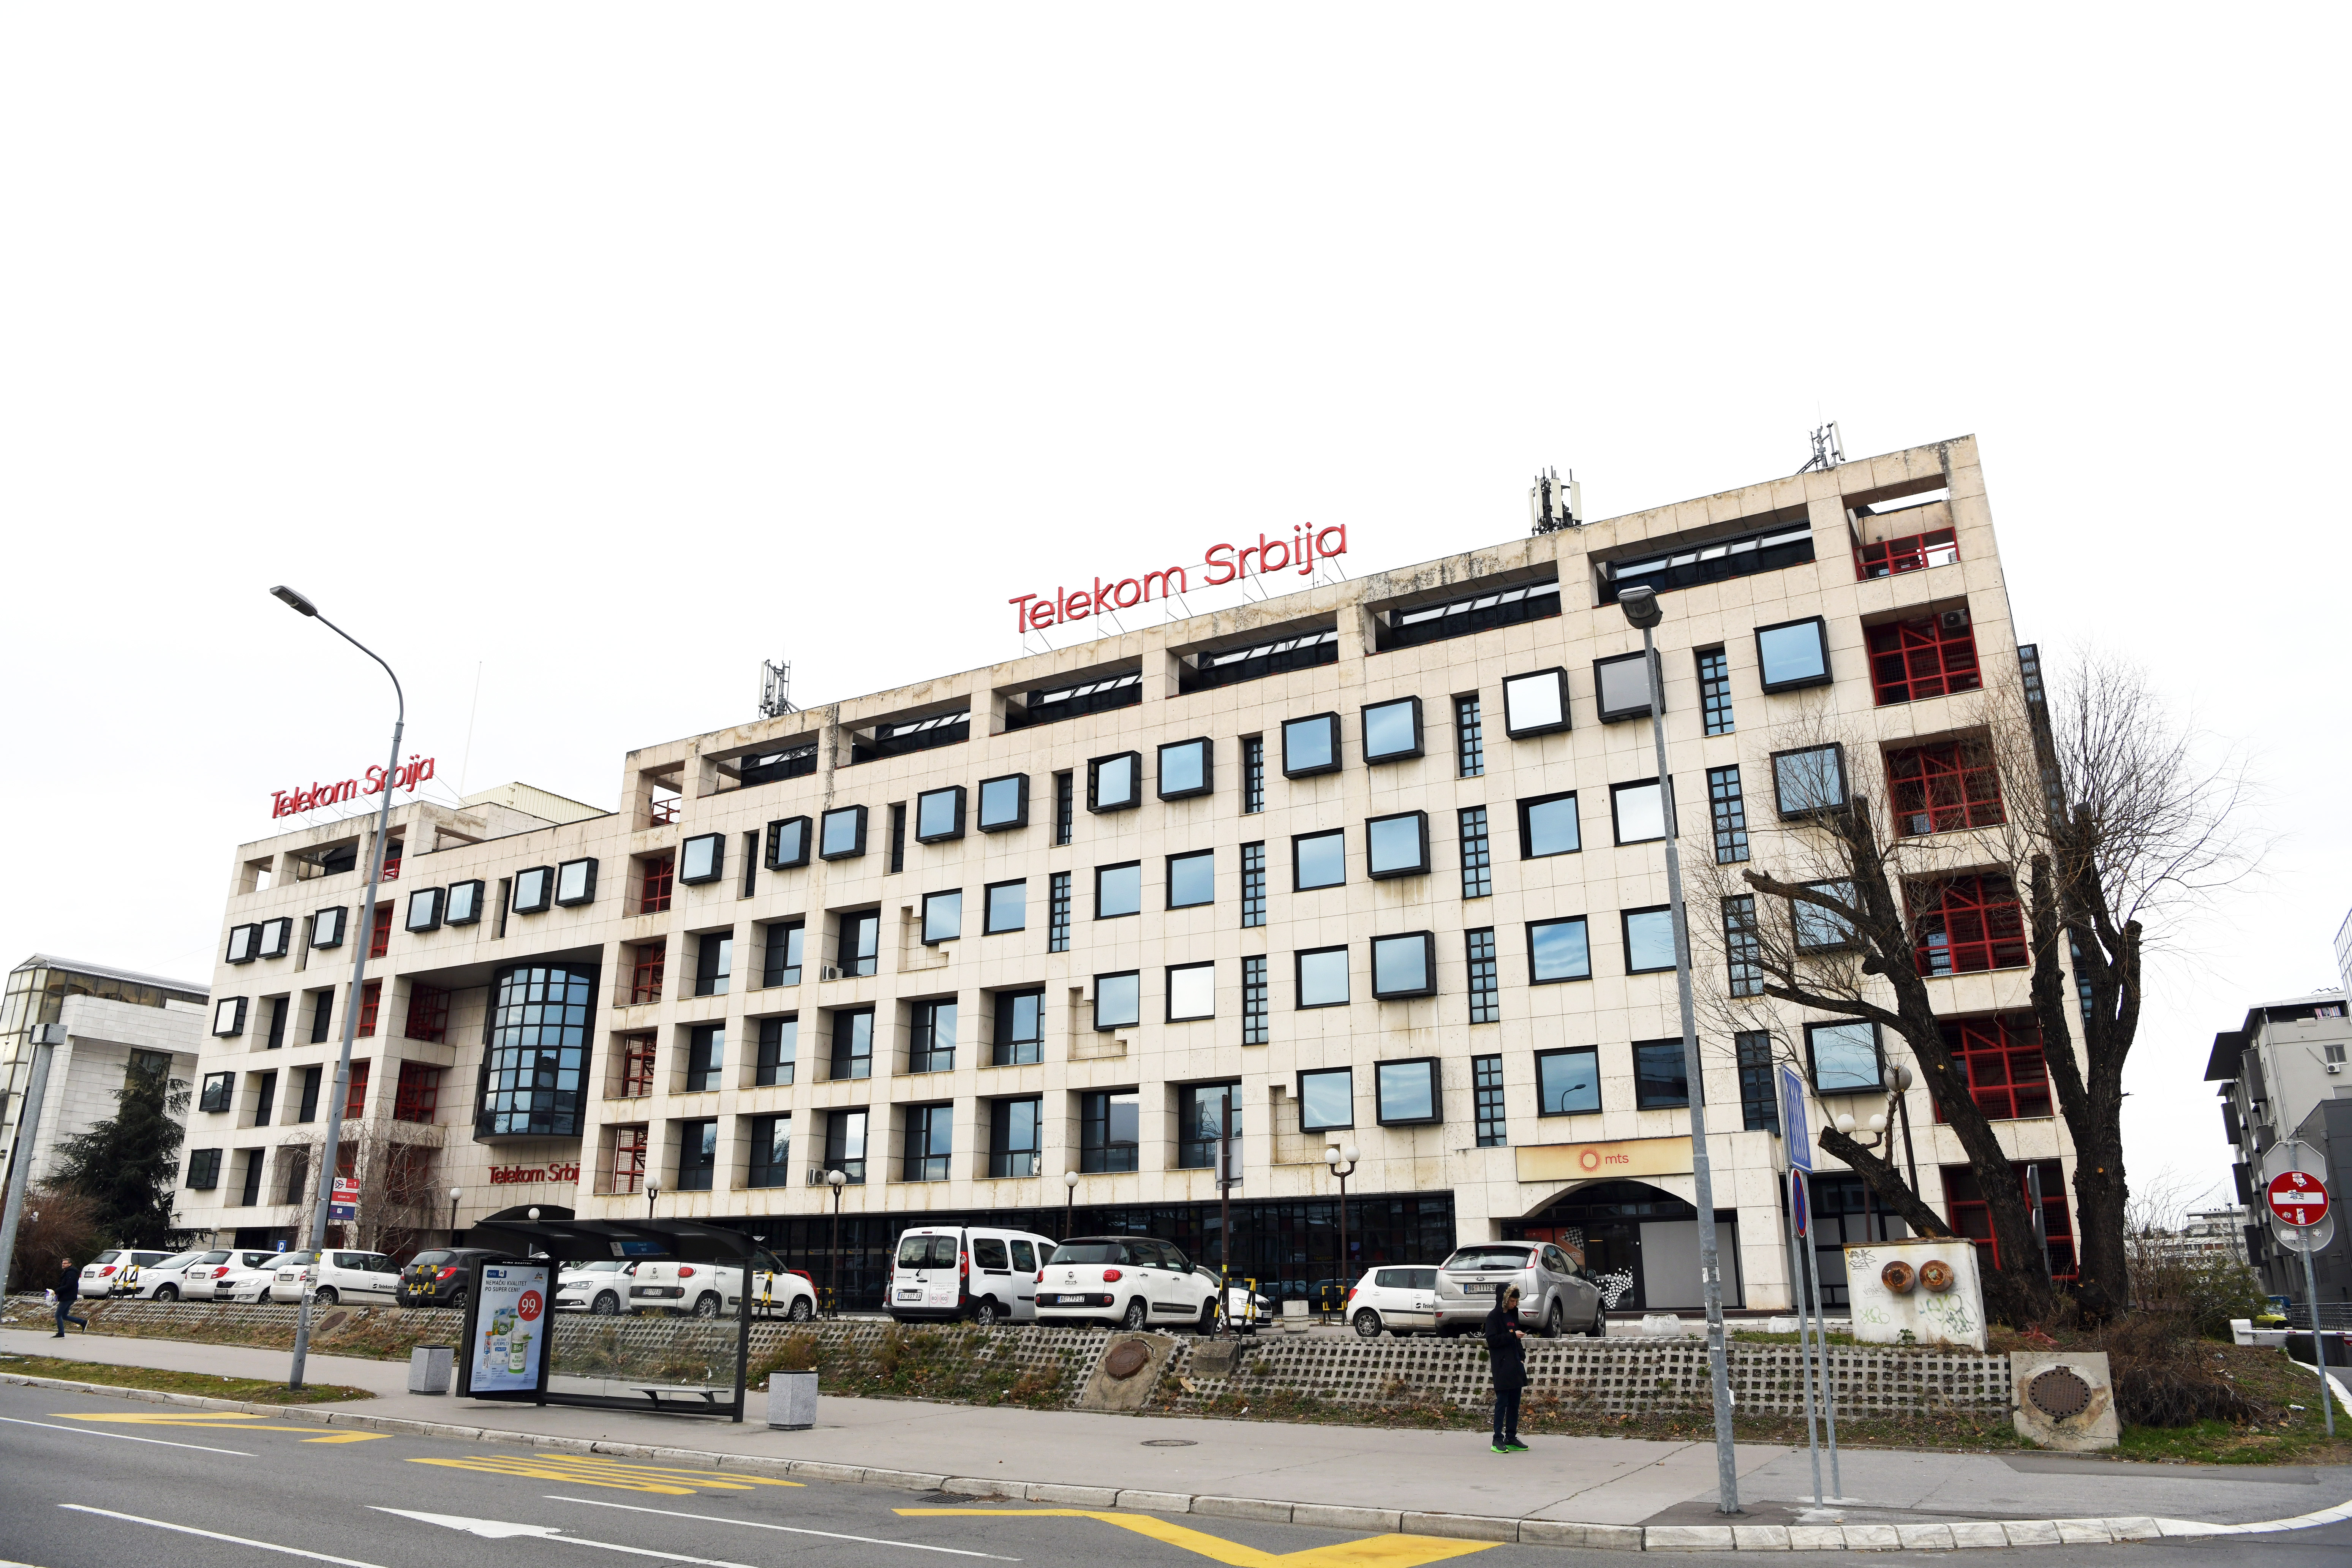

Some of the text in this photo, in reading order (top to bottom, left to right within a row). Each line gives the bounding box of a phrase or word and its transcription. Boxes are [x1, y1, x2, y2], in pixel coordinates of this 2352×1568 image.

[1008, 521, 1348, 634] Telekom Srbija
[270, 754, 435, 819] Telekom Srbija
[1605, 1154, 1629, 1164] mts
[488, 1163, 580, 1185] Telekom Srbij
[278, 1242, 284, 1252] P
[522, 1298, 536, 1314] 99
